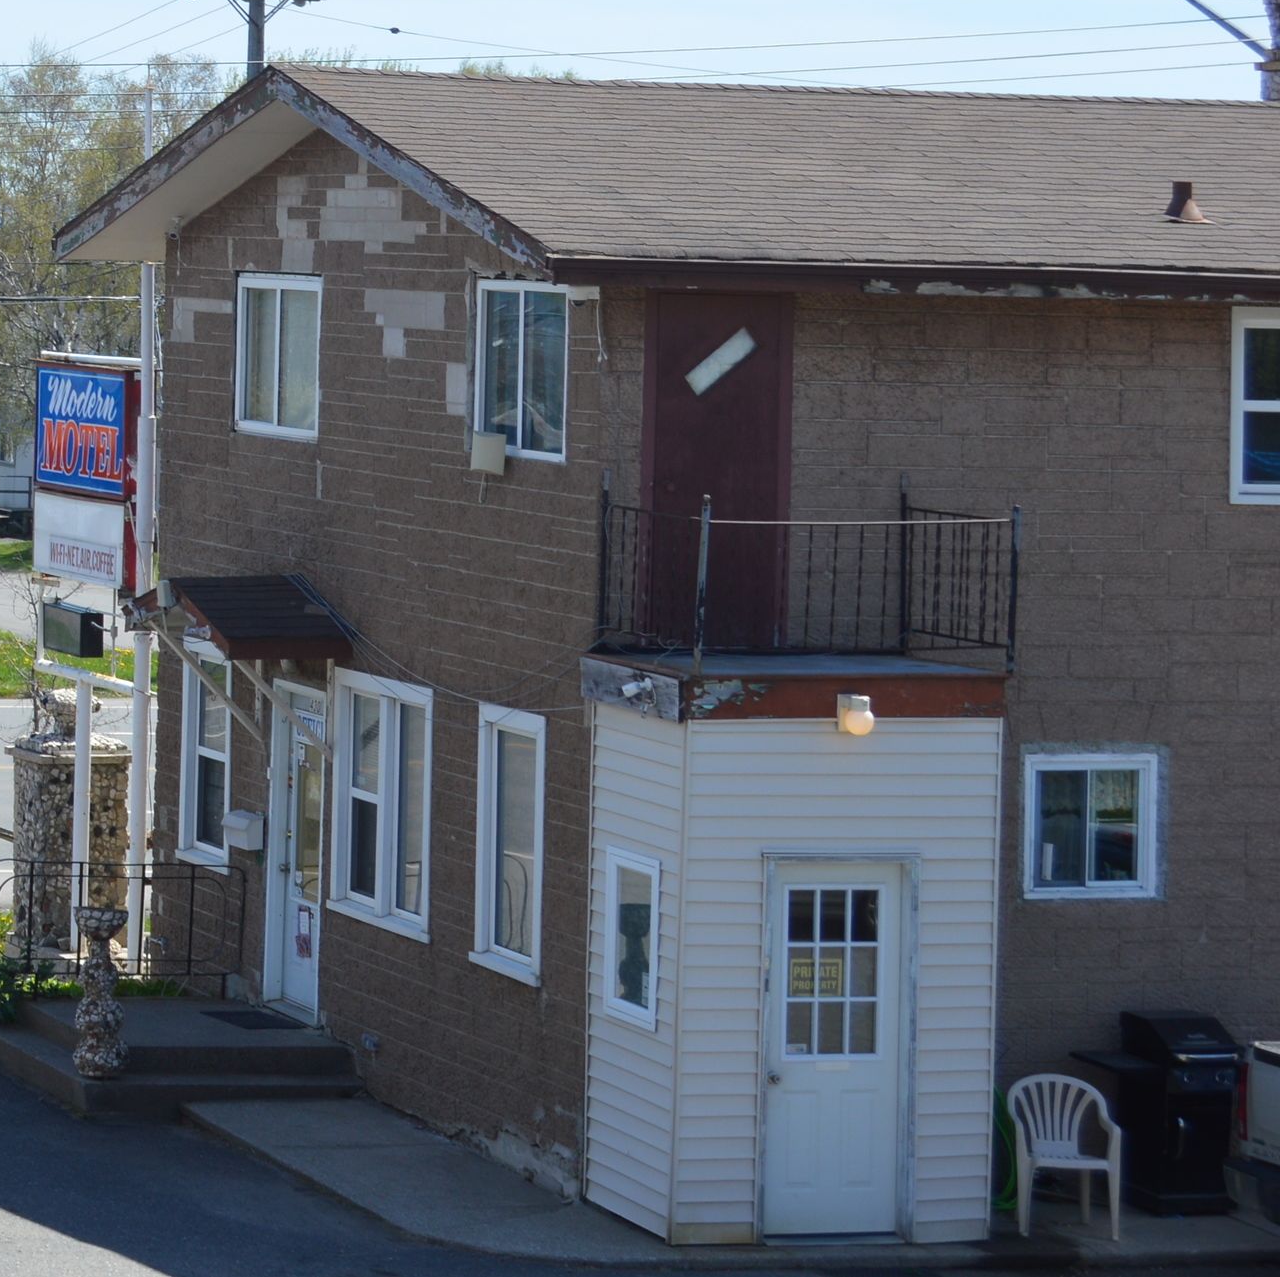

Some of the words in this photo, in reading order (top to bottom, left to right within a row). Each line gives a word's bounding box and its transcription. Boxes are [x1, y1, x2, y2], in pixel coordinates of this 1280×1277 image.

[47, 375, 117, 422] Modern
[40, 417, 124, 483] MOTEL
[793, 966, 838, 978] PRIATE
